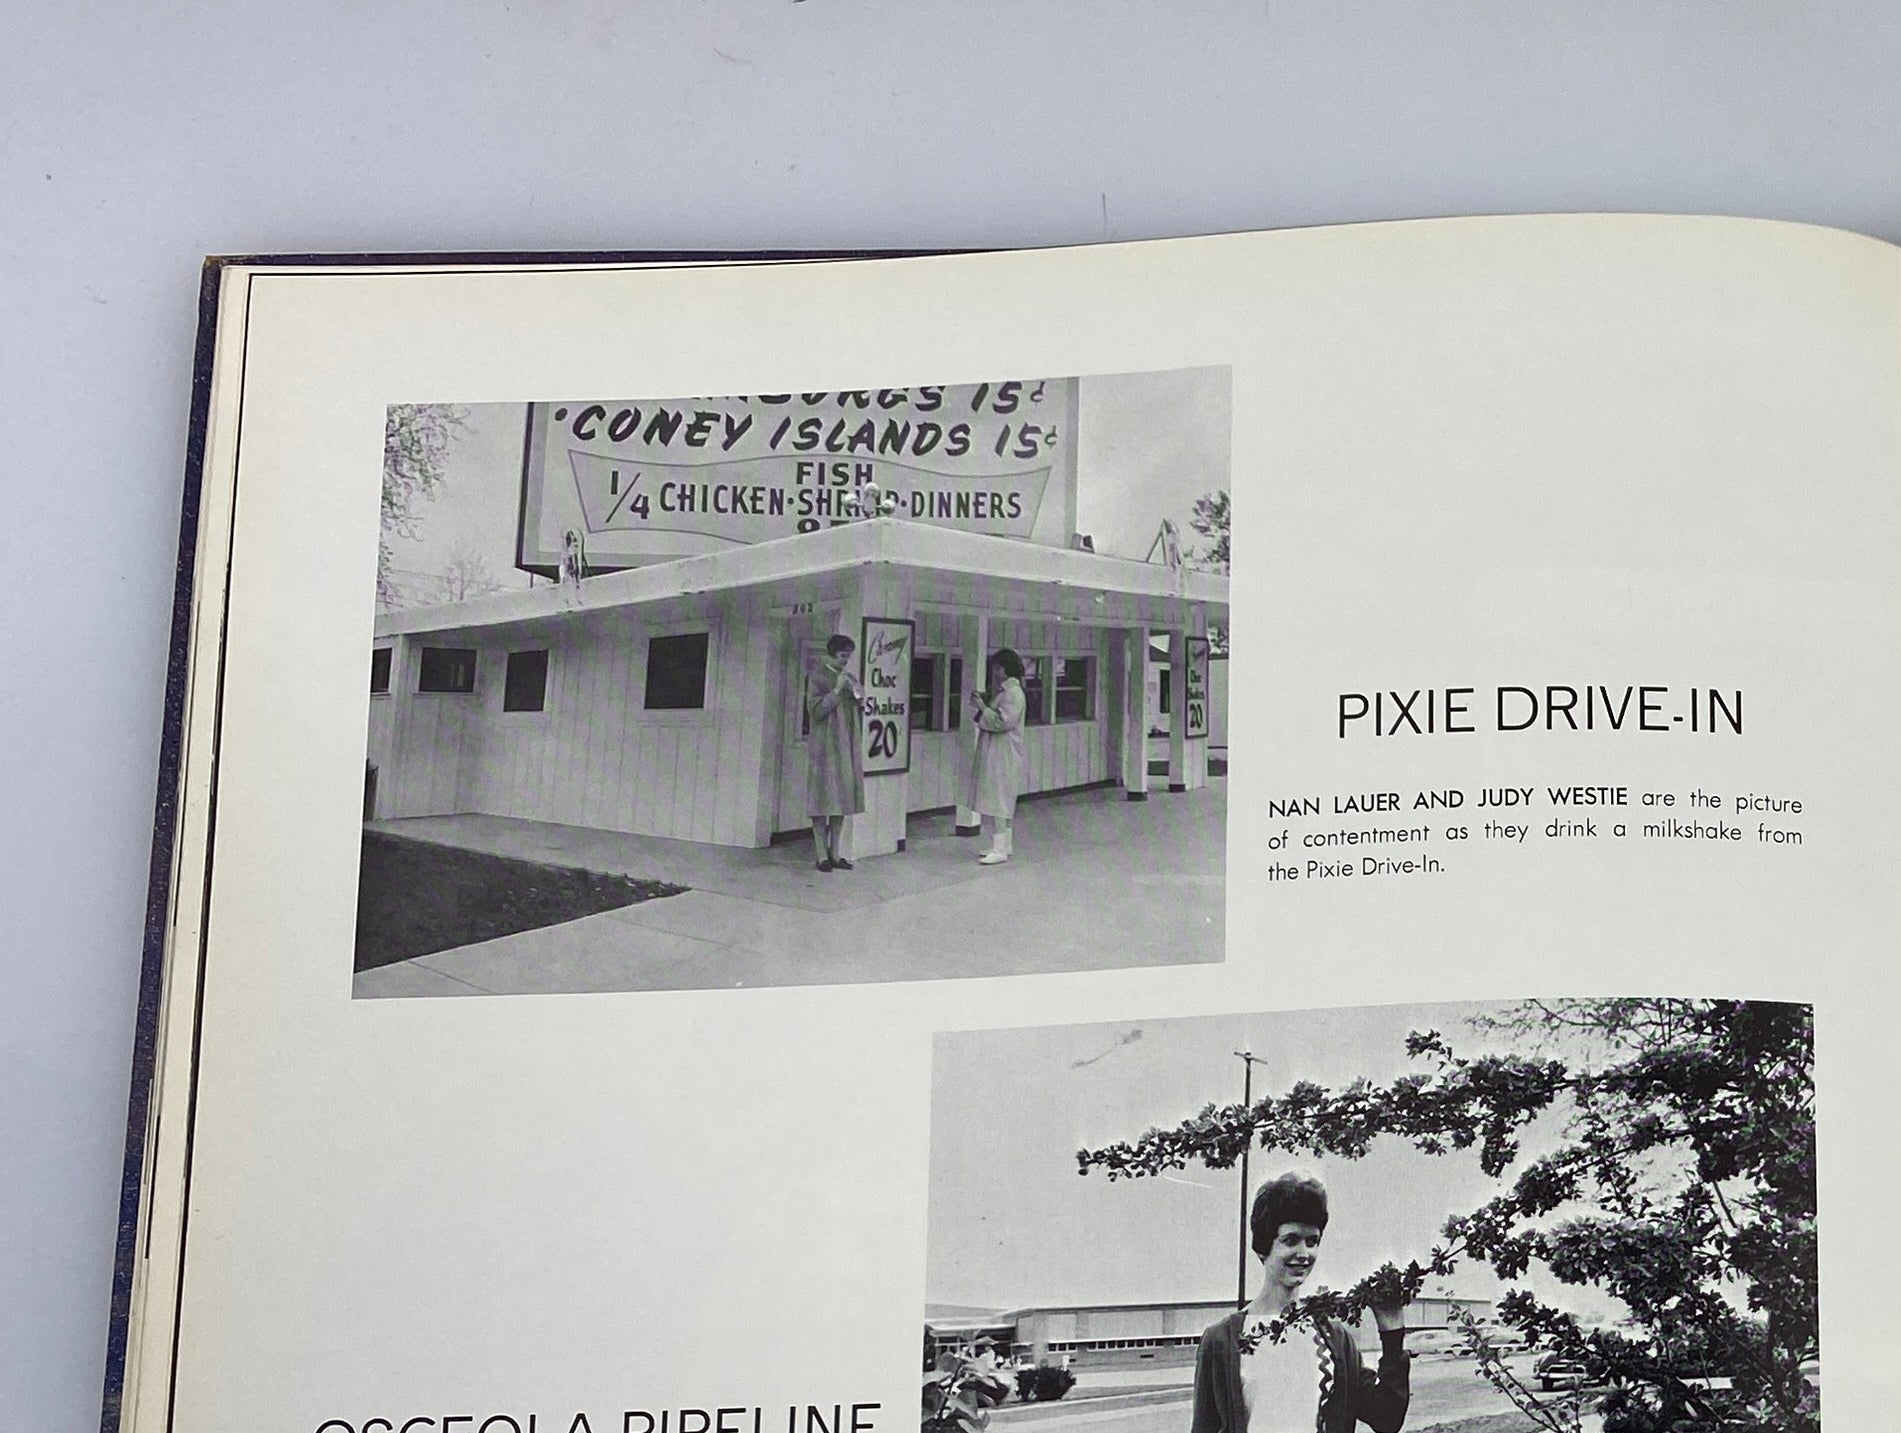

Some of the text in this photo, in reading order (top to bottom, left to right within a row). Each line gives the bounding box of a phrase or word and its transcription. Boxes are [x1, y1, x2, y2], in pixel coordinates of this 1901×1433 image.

[572, 404, 752, 451] CONEY
[769, 416, 971, 457] ISLANDS
[796, 462, 873, 486] FISH
[660, 482, 784, 516] CHICKEN
[911, 490, 1022, 519] DINNERS
[865, 697, 905, 716] Shakes
[1339, 685, 1743, 739] PIXIE DRIVE-IN
[868, 720, 898, 758] 20
[1269, 786, 1803, 819] NAN LAUER AND JUDY WESTIE are the picture
[1268, 817, 1803, 851] of contentment as they drink a milkshake from
[1267, 853, 1445, 882] the Pixie Drive-In.
